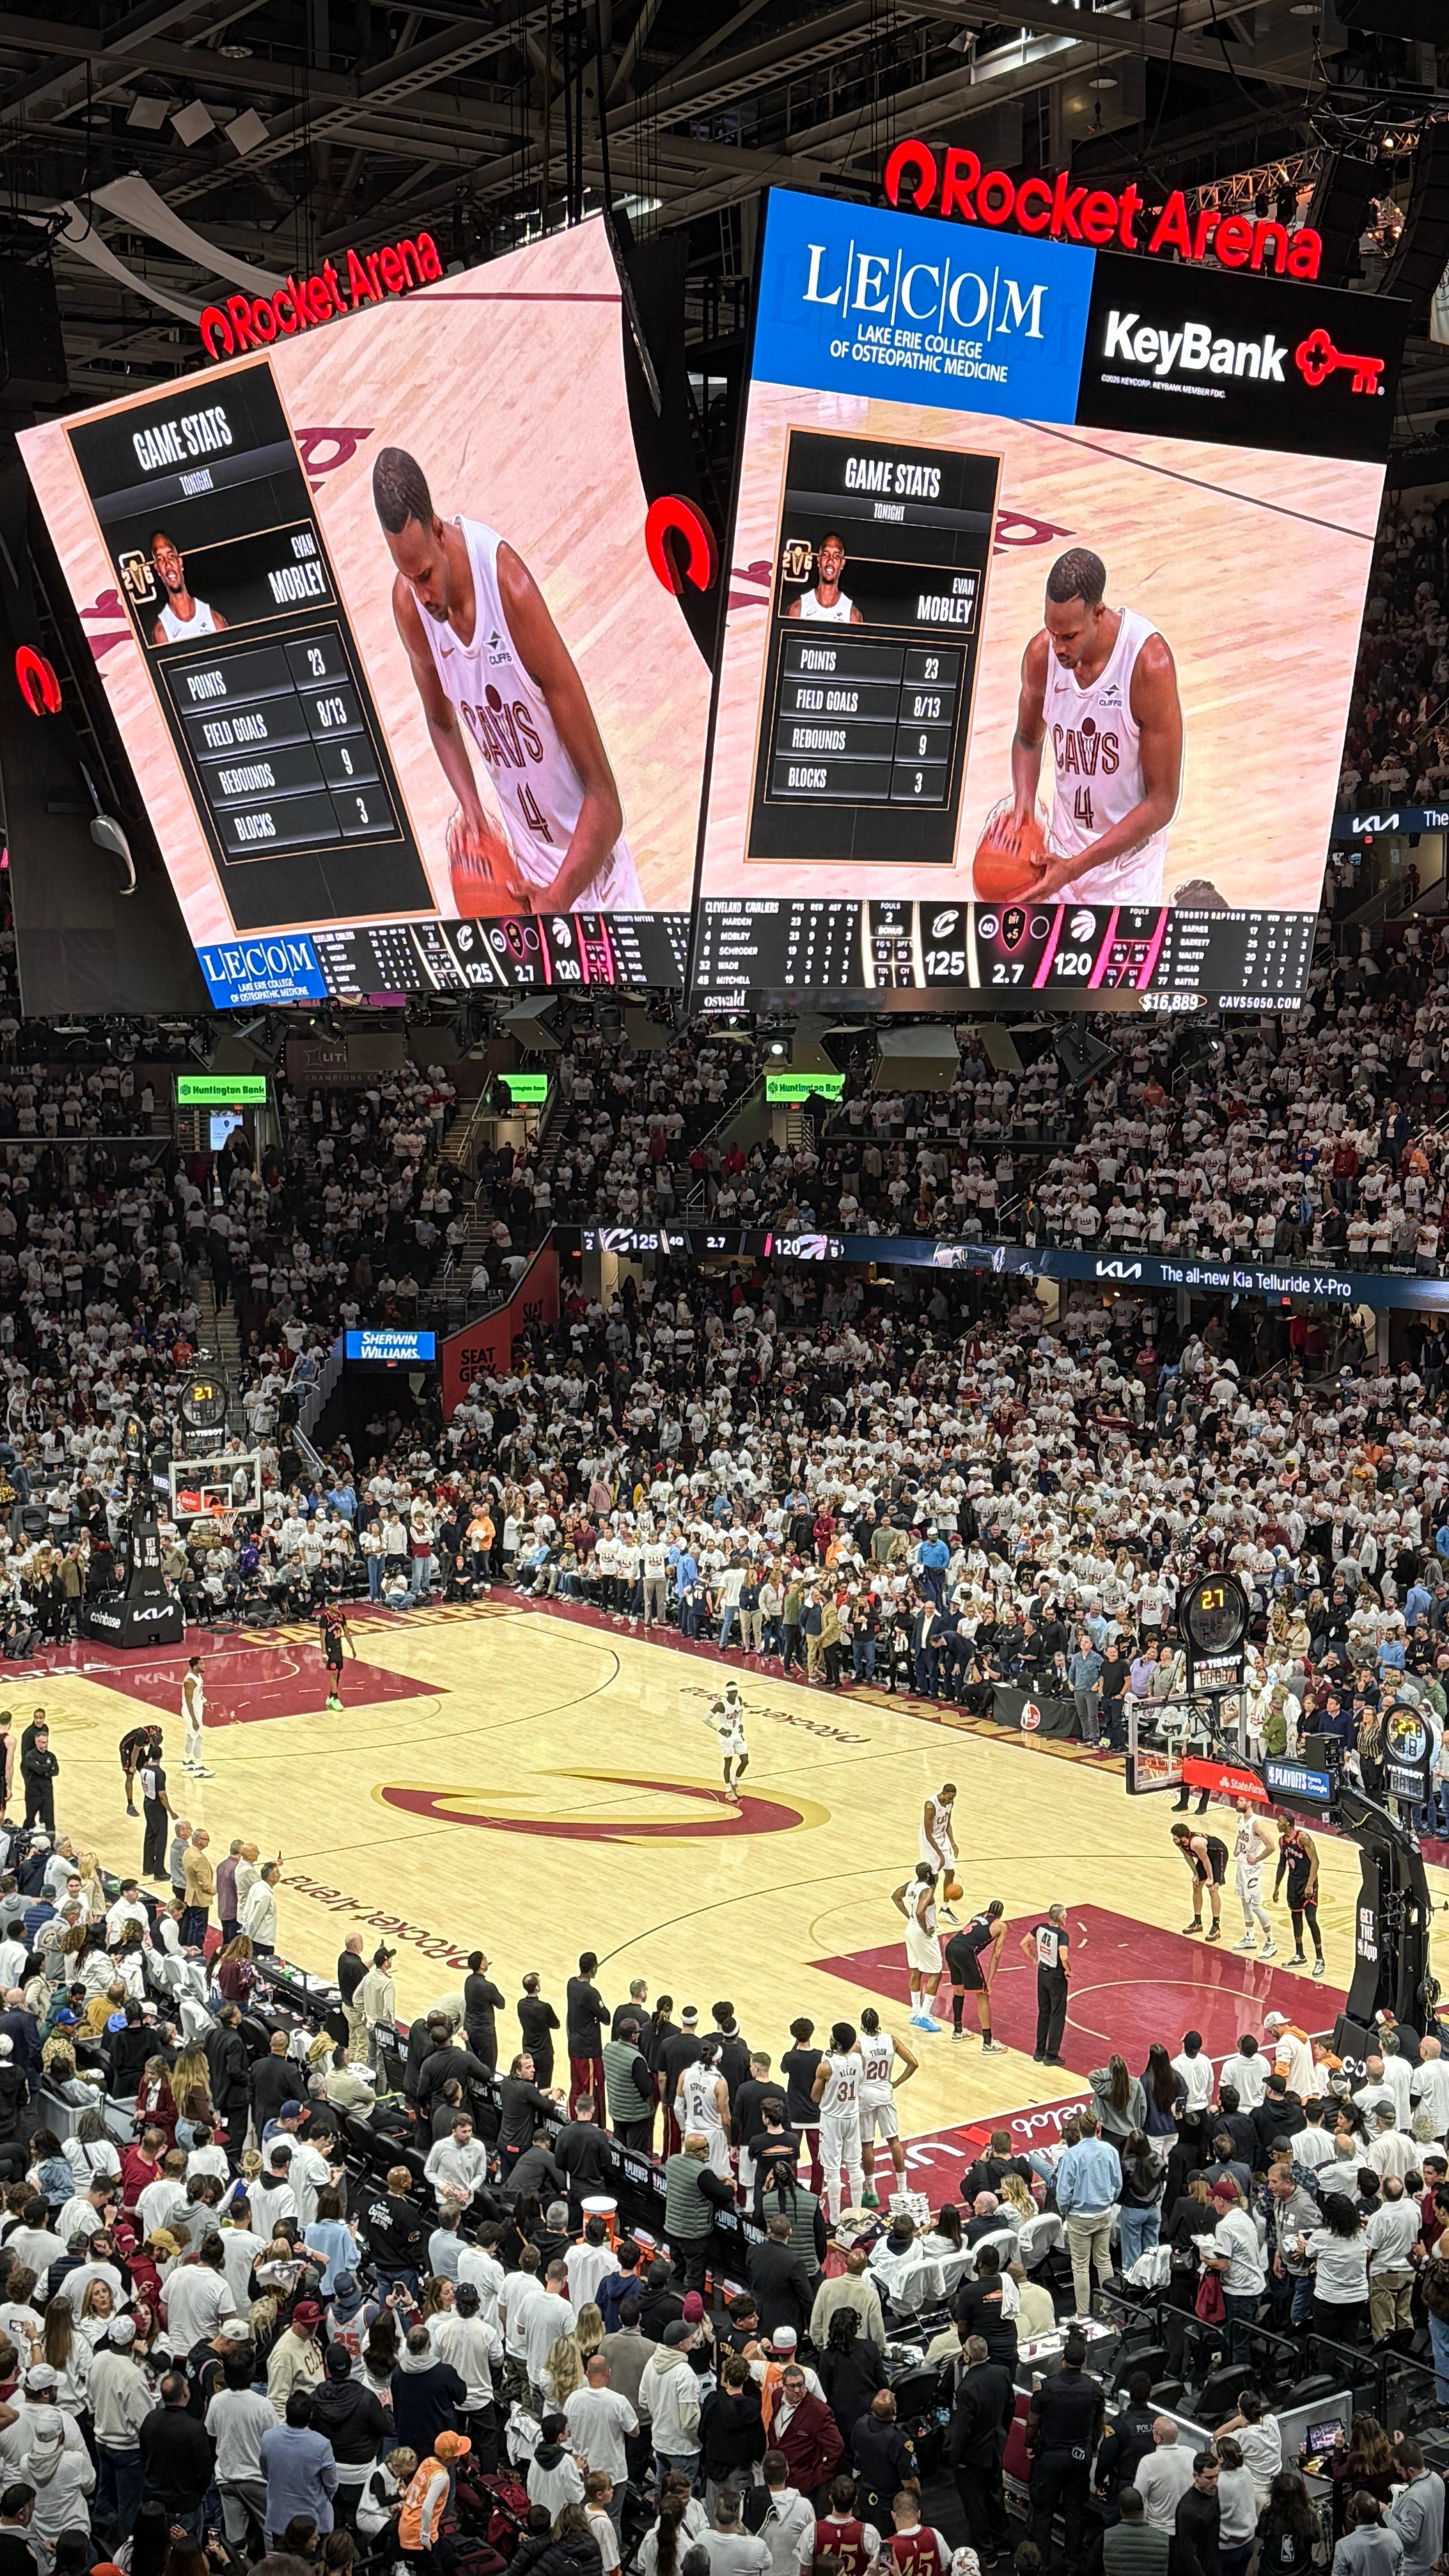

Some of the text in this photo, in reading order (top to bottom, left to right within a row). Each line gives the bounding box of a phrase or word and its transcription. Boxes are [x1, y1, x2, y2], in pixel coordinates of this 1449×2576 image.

[940, 147, 1322, 279] Rocket Arena
[227, 232, 443, 350] Rocket Arena
[858, 324, 983, 359] LAKE ERIE COLLEGE
[1104, 310, 1288, 382] KeyBank
[830, 340, 1008, 382] OF OSTEOPATHIC MEDICINE
[1153, 382, 1181, 392] KEYBANK
[1183, 385, 1210, 396] MEMBER
[133, 406, 232, 470] GAME STATS
[179, 469, 214, 496] TONIGHT
[845, 458, 941, 498] GAME STATS
[874, 503, 905, 521] TONIGHT
[291, 533, 316, 558] EVAN
[268, 561, 326, 604] MOBLEY
[952, 577, 975, 595] EVAN
[917, 595, 973, 624] MOBLEY
[800, 649, 938, 679] POINTS 23
[187, 648, 326, 701] POINTS 23
[796, 689, 941, 718] FIELD GOALS 8/13
[203, 698, 347, 748] FIELD GOALS 8/13
[460, 700, 543, 768] CAVS
[792, 728, 927, 755] REBOUNDS 9
[1053, 723, 1119, 776] CAVS
[218, 749, 353, 794] REBOUNDS 9
[788, 768, 923, 793] BLOCKS 3
[517, 782, 554, 843] 4
[1074, 785, 1094, 829] 4
[234, 797, 368, 841] BLOCKS 3
[1424, 811, 1449, 827] The
[705, 902, 779, 913] CLEVELAND CAVALIERS
[885, 912, 892, 923] 2
[1175, 911, 1246, 921] TORONTO RAPTORS
[722, 918, 752, 926] HARDEN
[705, 931, 712, 940] 4
[721, 932, 750, 940] MOBLEY
[466, 963, 493, 983] 125
[556, 960, 580, 980] 120
[925, 952, 965, 975] 125
[1054, 952, 1092, 975] 120
[716, 976, 750, 984] MITCHELL
[992, 964, 1024, 984] 2.7
[230, 986, 309, 1003] OF OSTEOPATHIC MEDICINE
[238, 982, 253, 992] LAKE
[267, 978, 294, 989] COLLEGE
[704, 990, 746, 1007] oswald
[1142, 994, 1198, 1012] $16,889
[1219, 996, 1301, 1009] CAVS5050.COM
[193, 1086, 241, 1096] Huntington
[586, 1239, 593, 1250] 2
[630, 1234, 658, 1249] 125
[706, 1237, 726, 1248] 2.7
[775, 1239, 800, 1256] 120
[831, 1247, 838, 1257] 5
[1161, 1265, 1182, 1283] The
[1185, 1267, 1229, 1286] all-new
[1233, 1270, 1252, 1288] Kia
[1256, 1272, 1311, 1293] Telluride
[1313, 1277, 1351, 1297] X-Pro
[361, 1331, 418, 1345] SHERWIN
[461, 1346, 496, 1366] SEAT
[193, 1387, 212, 1401] 27
[197, 1429, 224, 1437] TISSOT
[1202, 1590, 1224, 1610] 27
[90, 1611, 121, 1629] coinbase
[239, 1601, 524, 1646] CAALIERS
[1207, 1655, 1242, 1667] TISSOT
[0, 1663, 110, 1682] LTRA
[1398, 1719, 1416, 1736] 27
[1275, 1767, 1307, 1789] PLAYOFFS
[1396, 1767, 1424, 1780] TISSOT
[1308, 1783, 1327, 1794] Google
[280, 1875, 469, 1960] Rocket Arena
[1361, 1923, 1374, 1941] THE
[866, 2060, 888, 2080] 20
[837, 2081, 856, 2102] 31
[693, 2096, 703, 2116] 2
